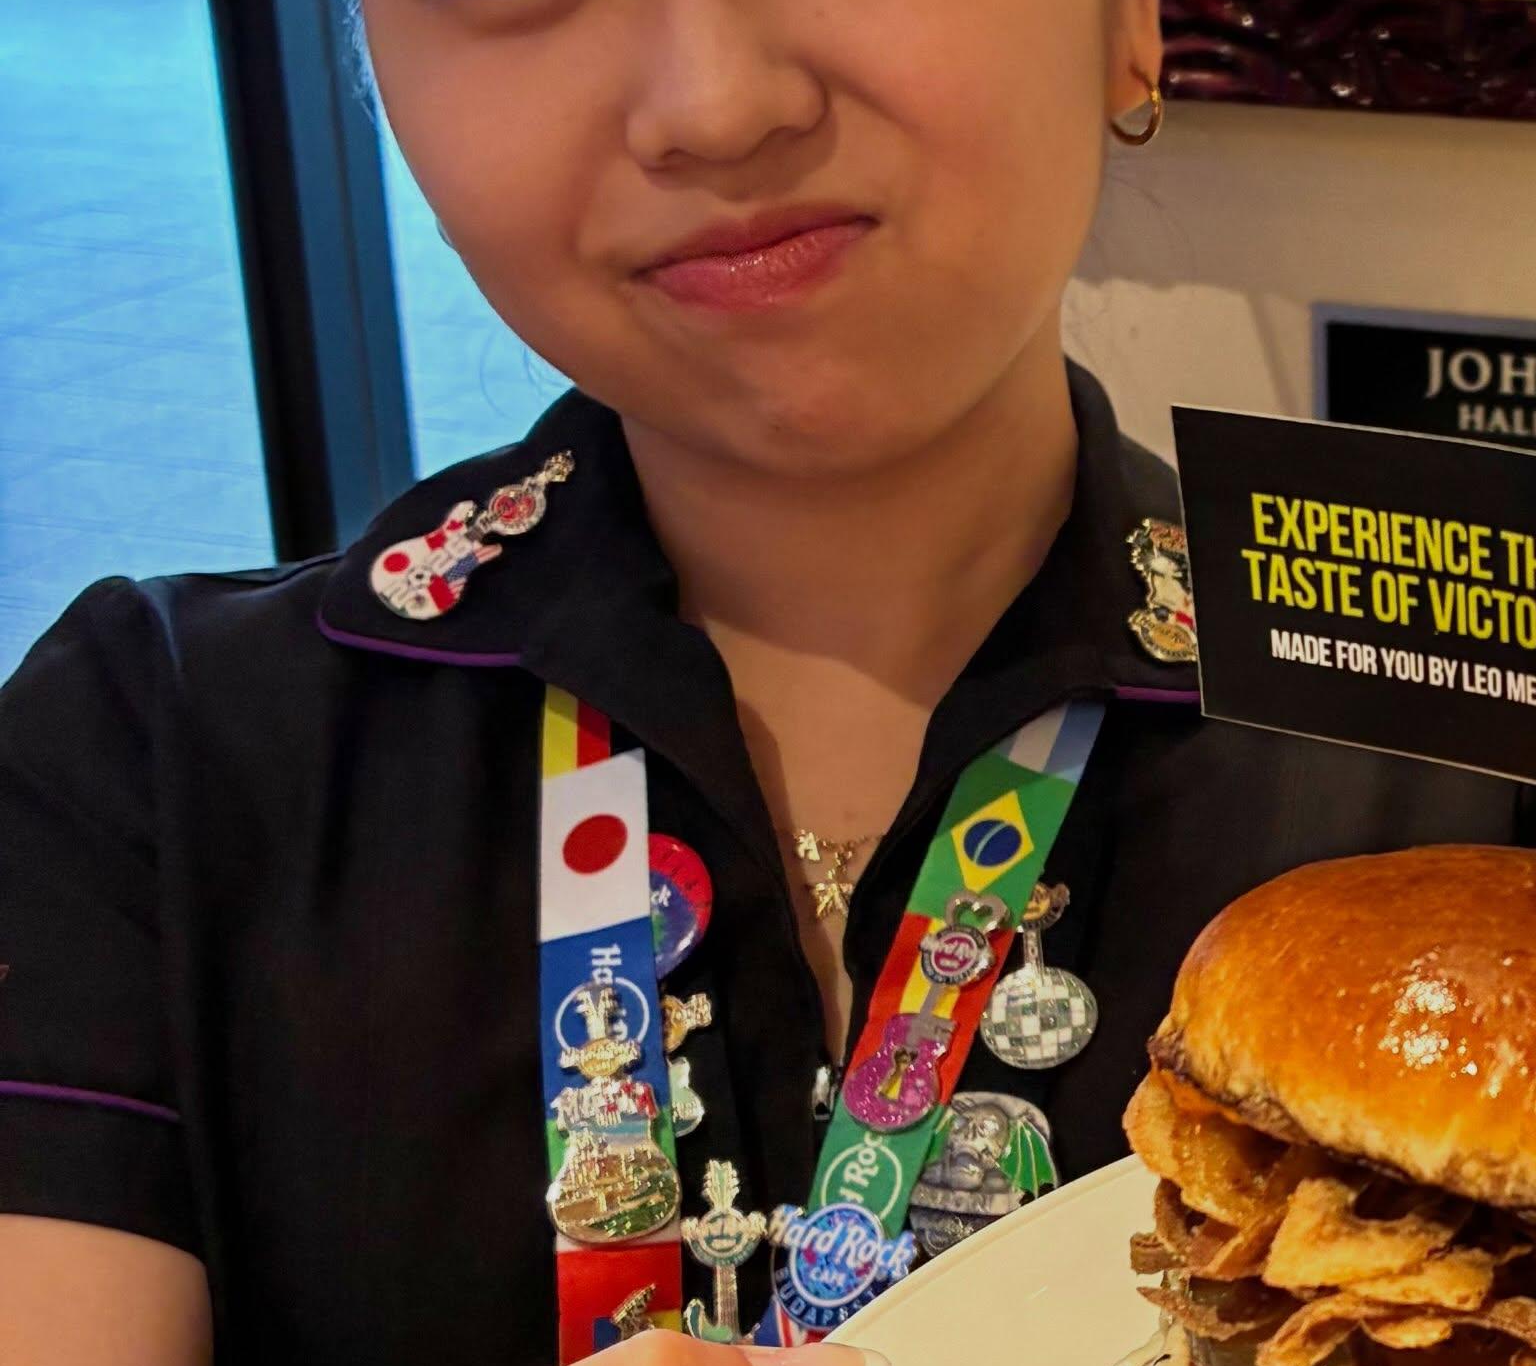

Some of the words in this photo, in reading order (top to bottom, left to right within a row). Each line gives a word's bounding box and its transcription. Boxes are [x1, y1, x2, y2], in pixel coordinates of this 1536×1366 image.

[1250, 491, 1494, 581] EXPERIENCE
[1241, 549, 1364, 619] TASTE
[1371, 570, 1420, 626] OF
[1270, 628, 1333, 668] MADE
[1335, 641, 1378, 676] FOR
[1379, 648, 1425, 685] YOU
[1429, 656, 1459, 691] BY
[1462, 663, 1501, 699] LEO
[843, 1130, 885, 1187] Roc
[768, 1203, 841, 1254] Hard
[833, 1229, 918, 1281] Rock
